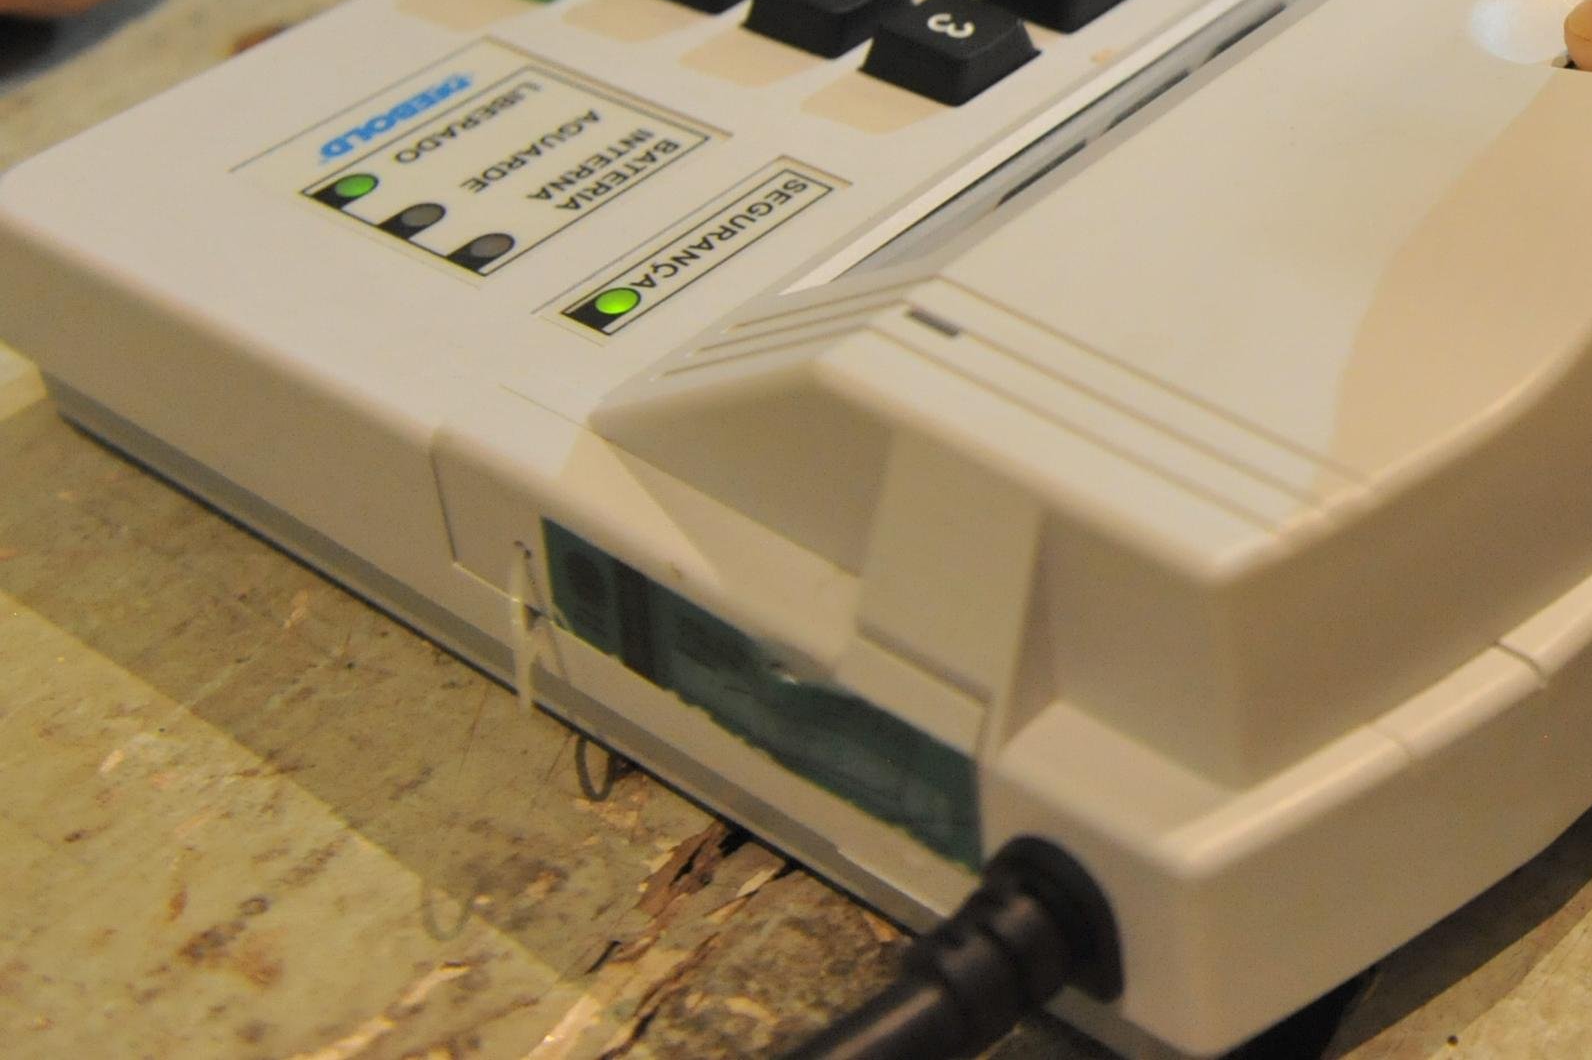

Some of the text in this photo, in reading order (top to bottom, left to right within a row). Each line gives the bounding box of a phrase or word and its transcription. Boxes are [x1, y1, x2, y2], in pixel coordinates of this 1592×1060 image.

[926, 12, 976, 39] 3
[394, 81, 543, 163] LIBERADO
[460, 109, 601, 194] AGUARDE
[526, 127, 655, 201] INTERNA
[555, 138, 680, 212] BATERIA
[630, 178, 808, 288] SEGURANÇA
